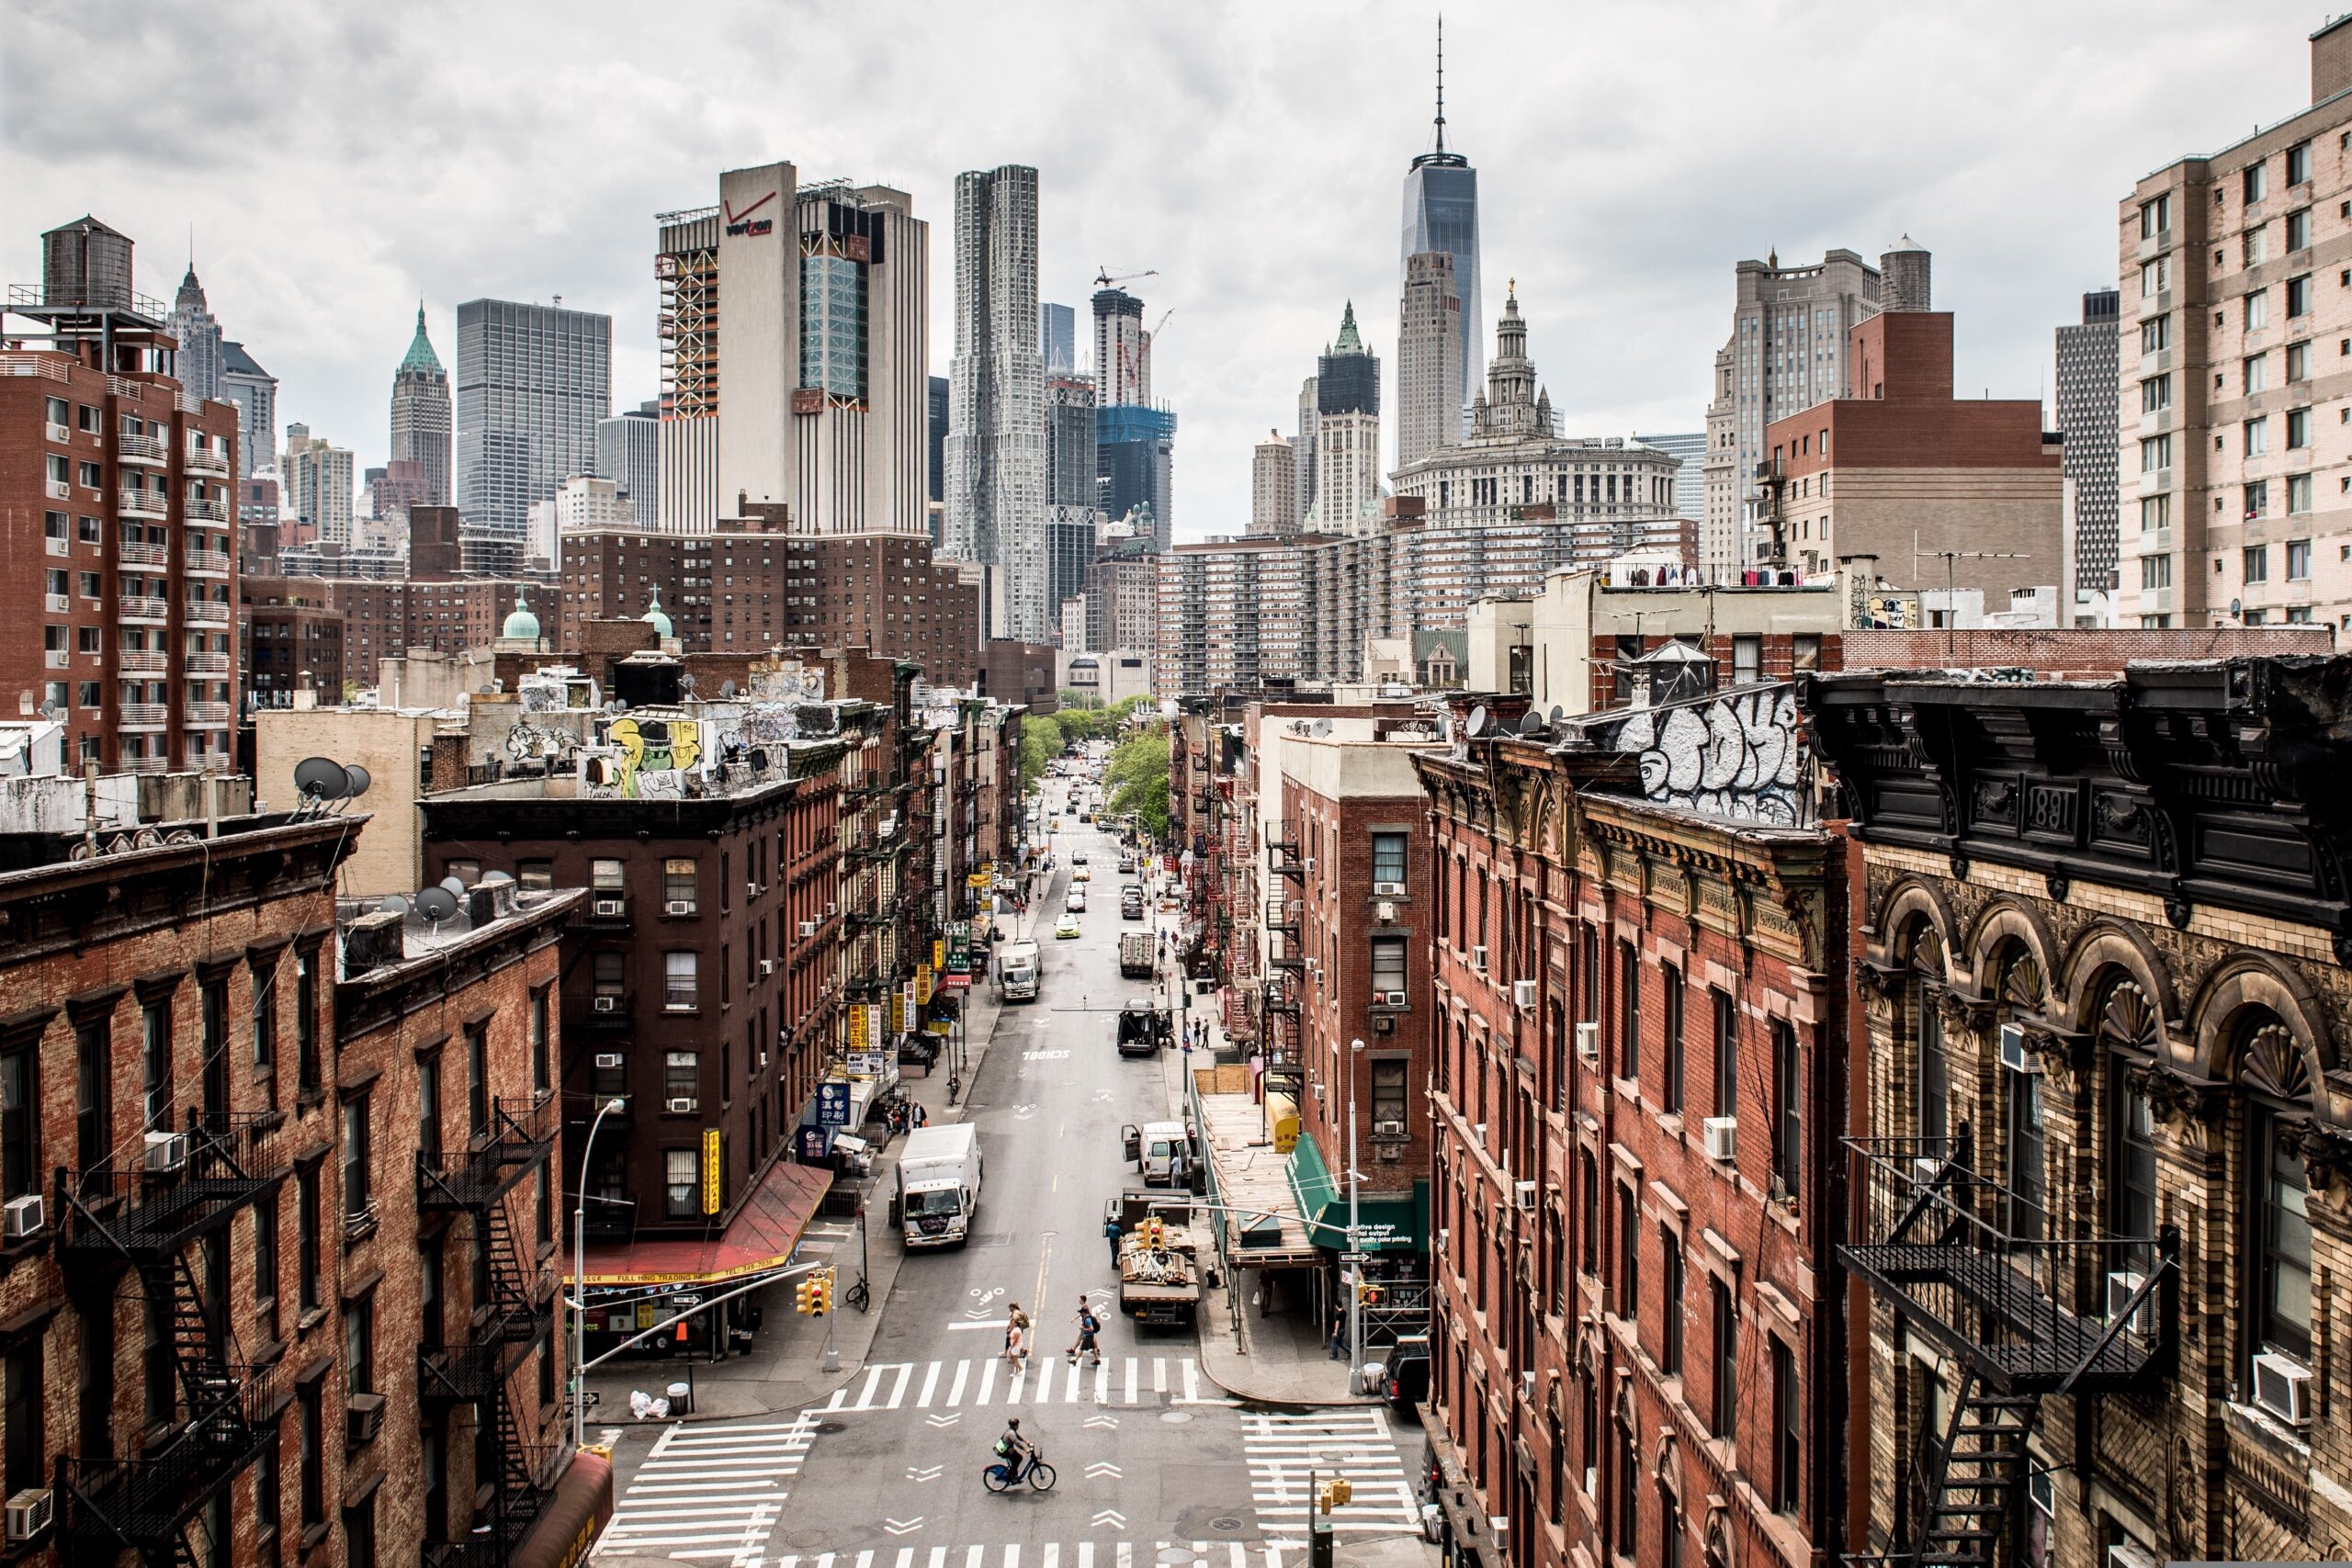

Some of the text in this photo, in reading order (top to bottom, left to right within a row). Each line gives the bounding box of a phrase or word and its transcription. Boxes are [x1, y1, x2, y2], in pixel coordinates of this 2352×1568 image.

[726, 219, 772, 236] verizon
[2028, 786, 2073, 833] 1891
[1023, 1049, 1070, 1061] SCHOOL
